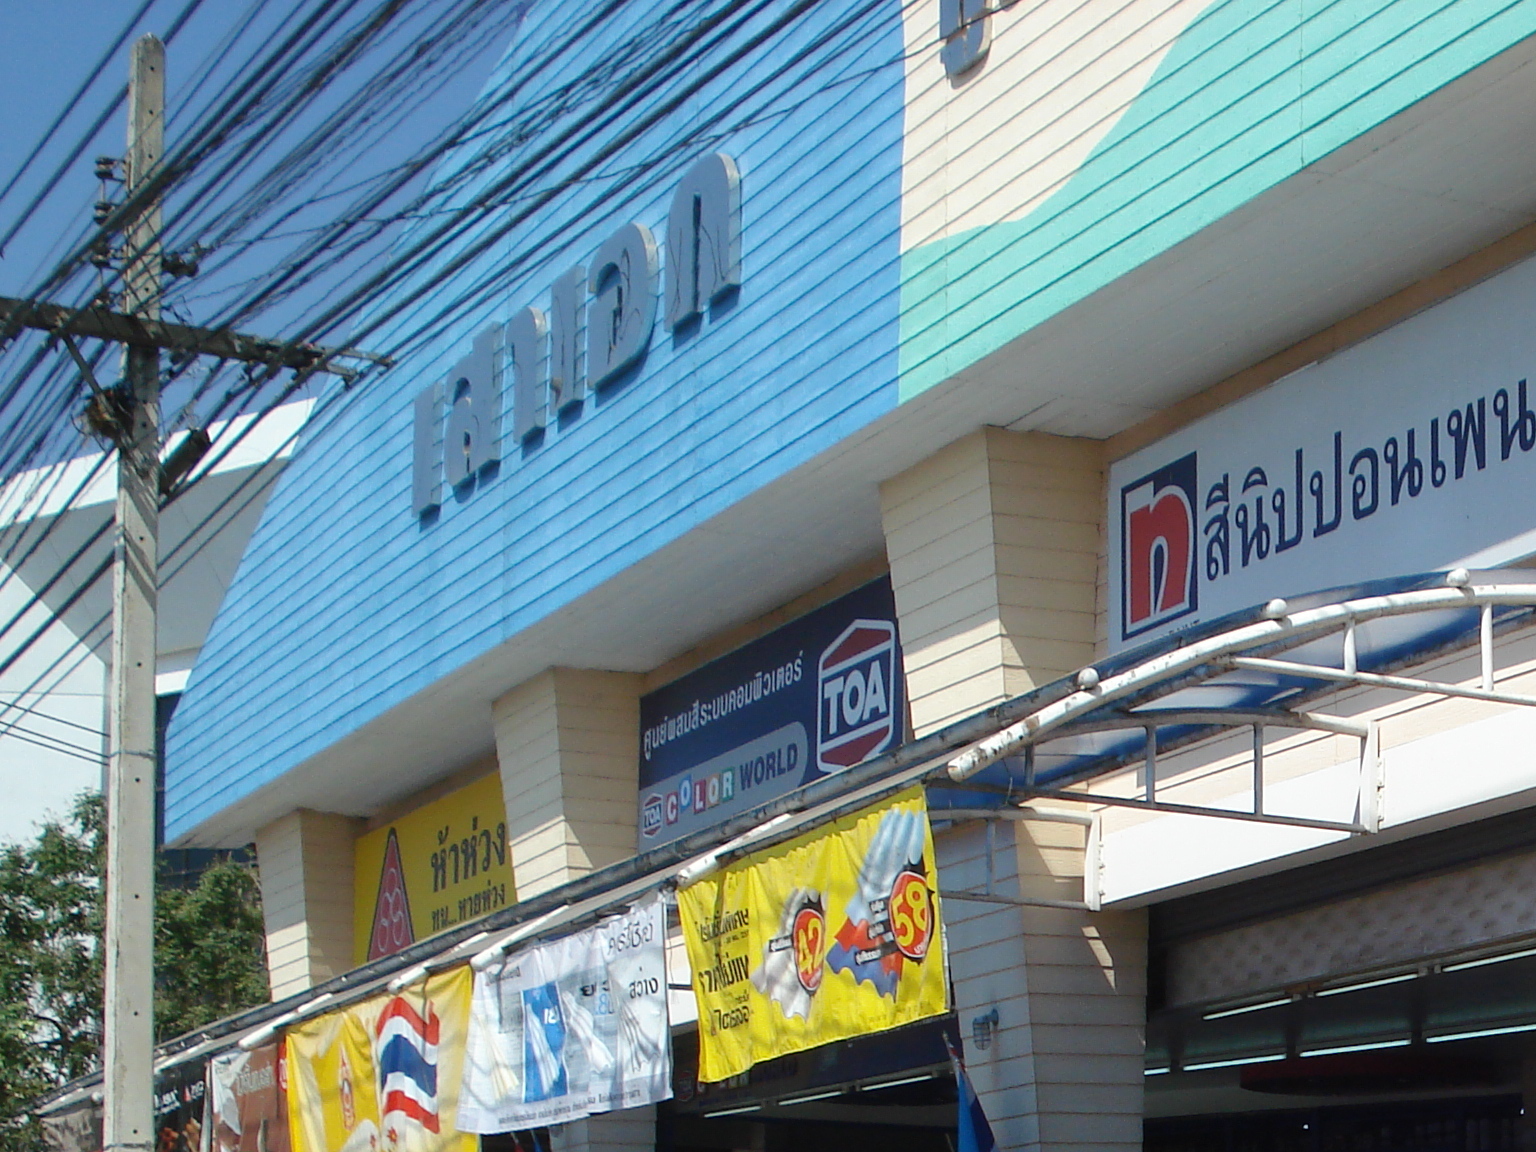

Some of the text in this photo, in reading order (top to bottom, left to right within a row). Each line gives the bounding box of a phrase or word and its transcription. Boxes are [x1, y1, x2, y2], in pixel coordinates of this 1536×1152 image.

[823, 660, 887, 735] TOA
[643, 742, 799, 831] TOA COLOR WORLD
[431, 816, 506, 893] ห้าห่วง
[798, 918, 823, 976] 42
[891, 881, 929, 946] 58
